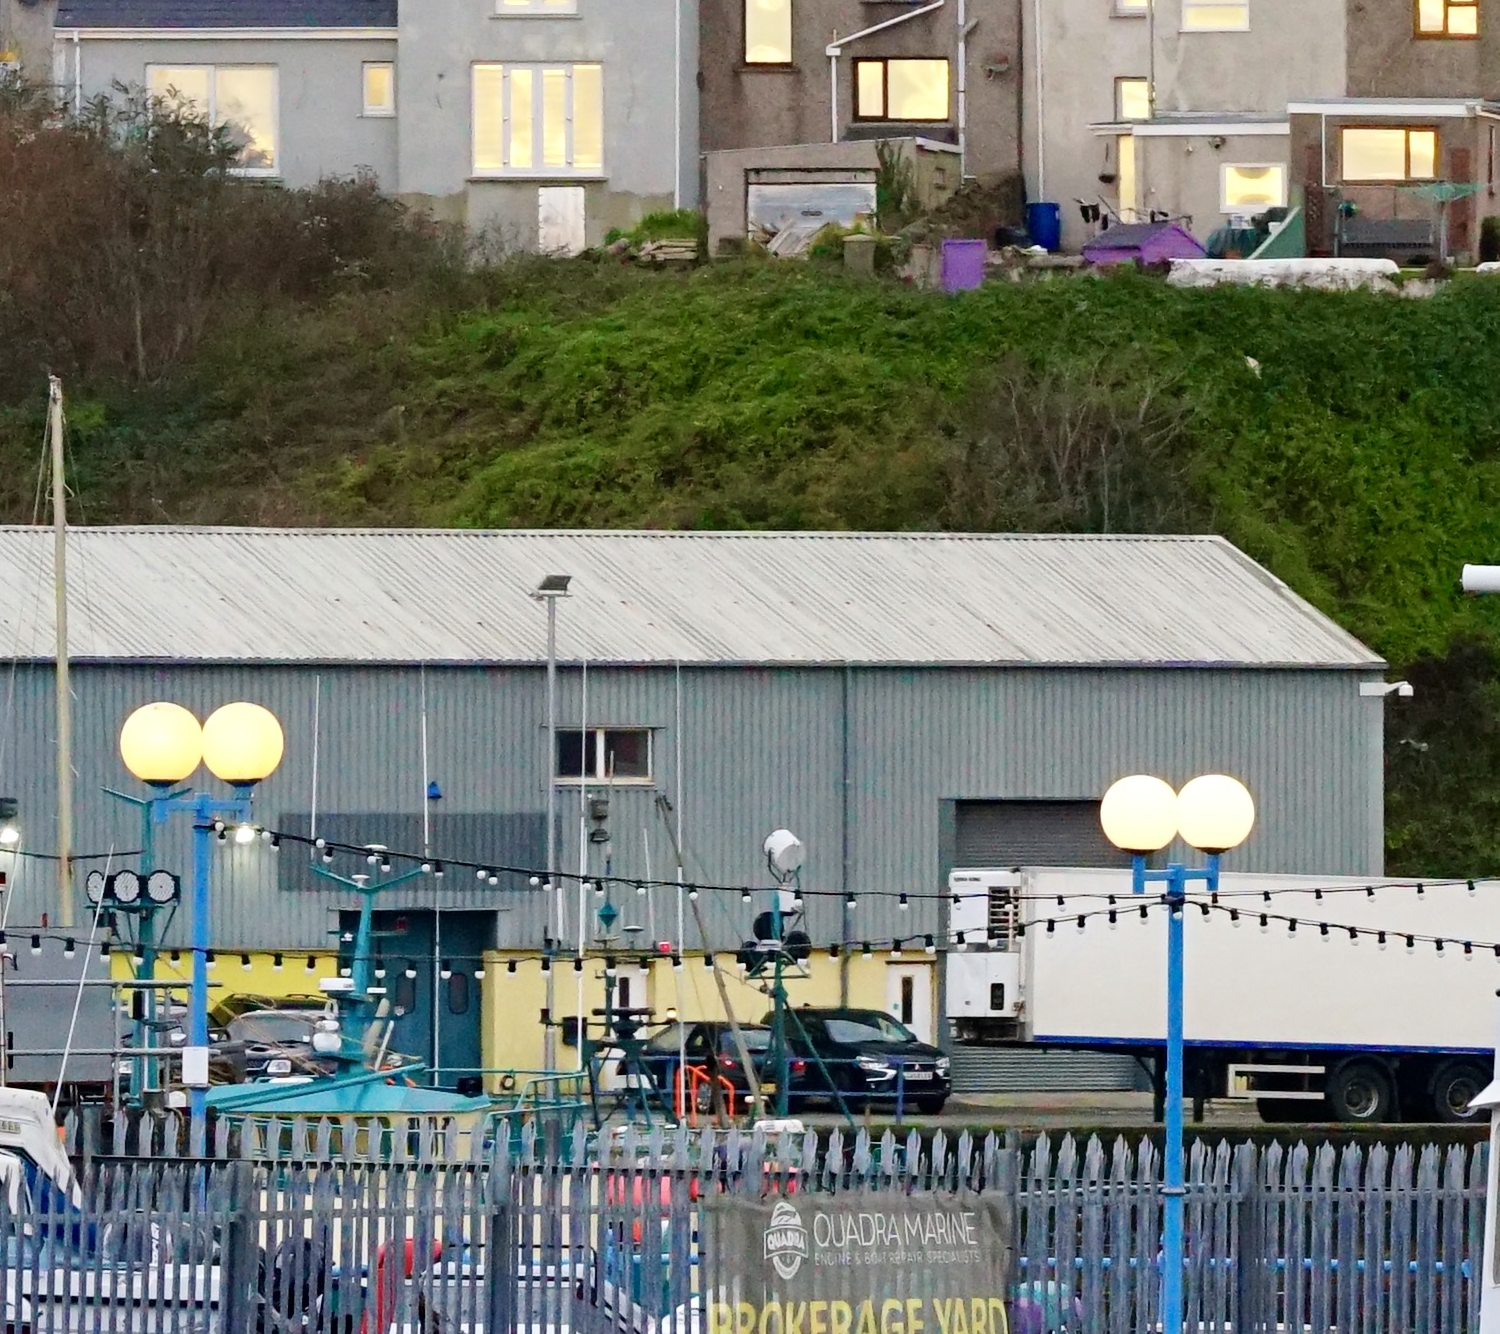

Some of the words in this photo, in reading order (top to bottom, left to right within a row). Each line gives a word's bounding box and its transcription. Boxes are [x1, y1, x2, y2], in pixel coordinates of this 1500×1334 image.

[813, 1212, 902, 1247] QUADRA
[903, 1212, 979, 1246] MARINE
[767, 1230, 805, 1251] QUADRA
[815, 1252, 852, 1266] ENGINE
[865, 1252, 887, 1265] BOAT
[890, 1251, 923, 1265] REPAIR
[927, 1250, 981, 1265] SPECIALISTS
